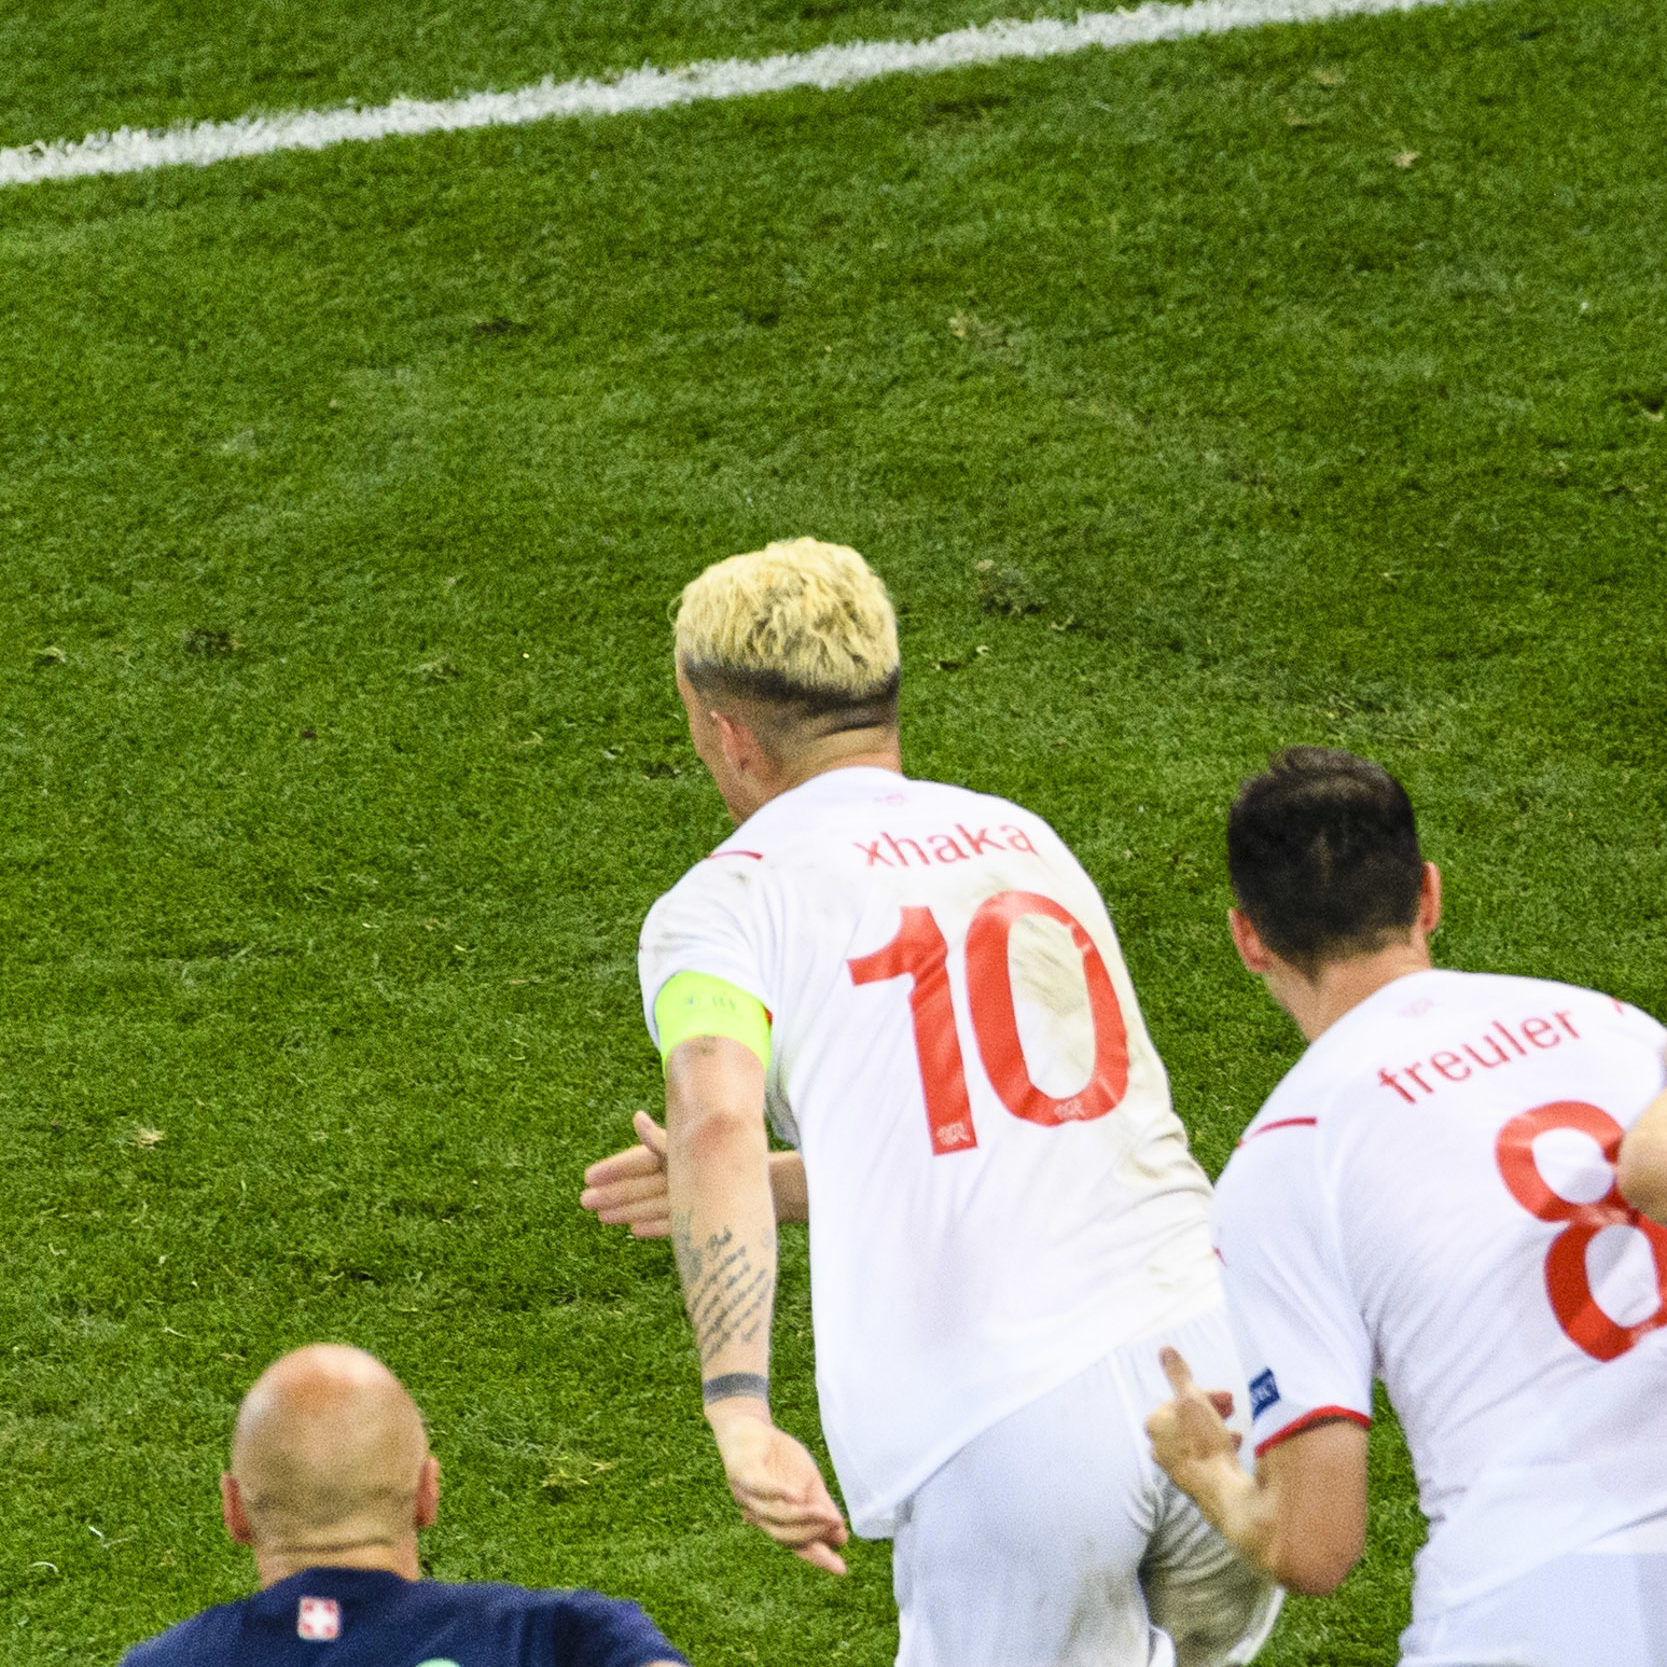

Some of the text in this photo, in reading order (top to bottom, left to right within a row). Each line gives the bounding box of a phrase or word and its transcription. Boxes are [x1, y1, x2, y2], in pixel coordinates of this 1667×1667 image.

[853, 823, 1040, 867] xhaka
[846, 890, 1129, 1156] 10
[1377, 1008, 1581, 1105] freuler
